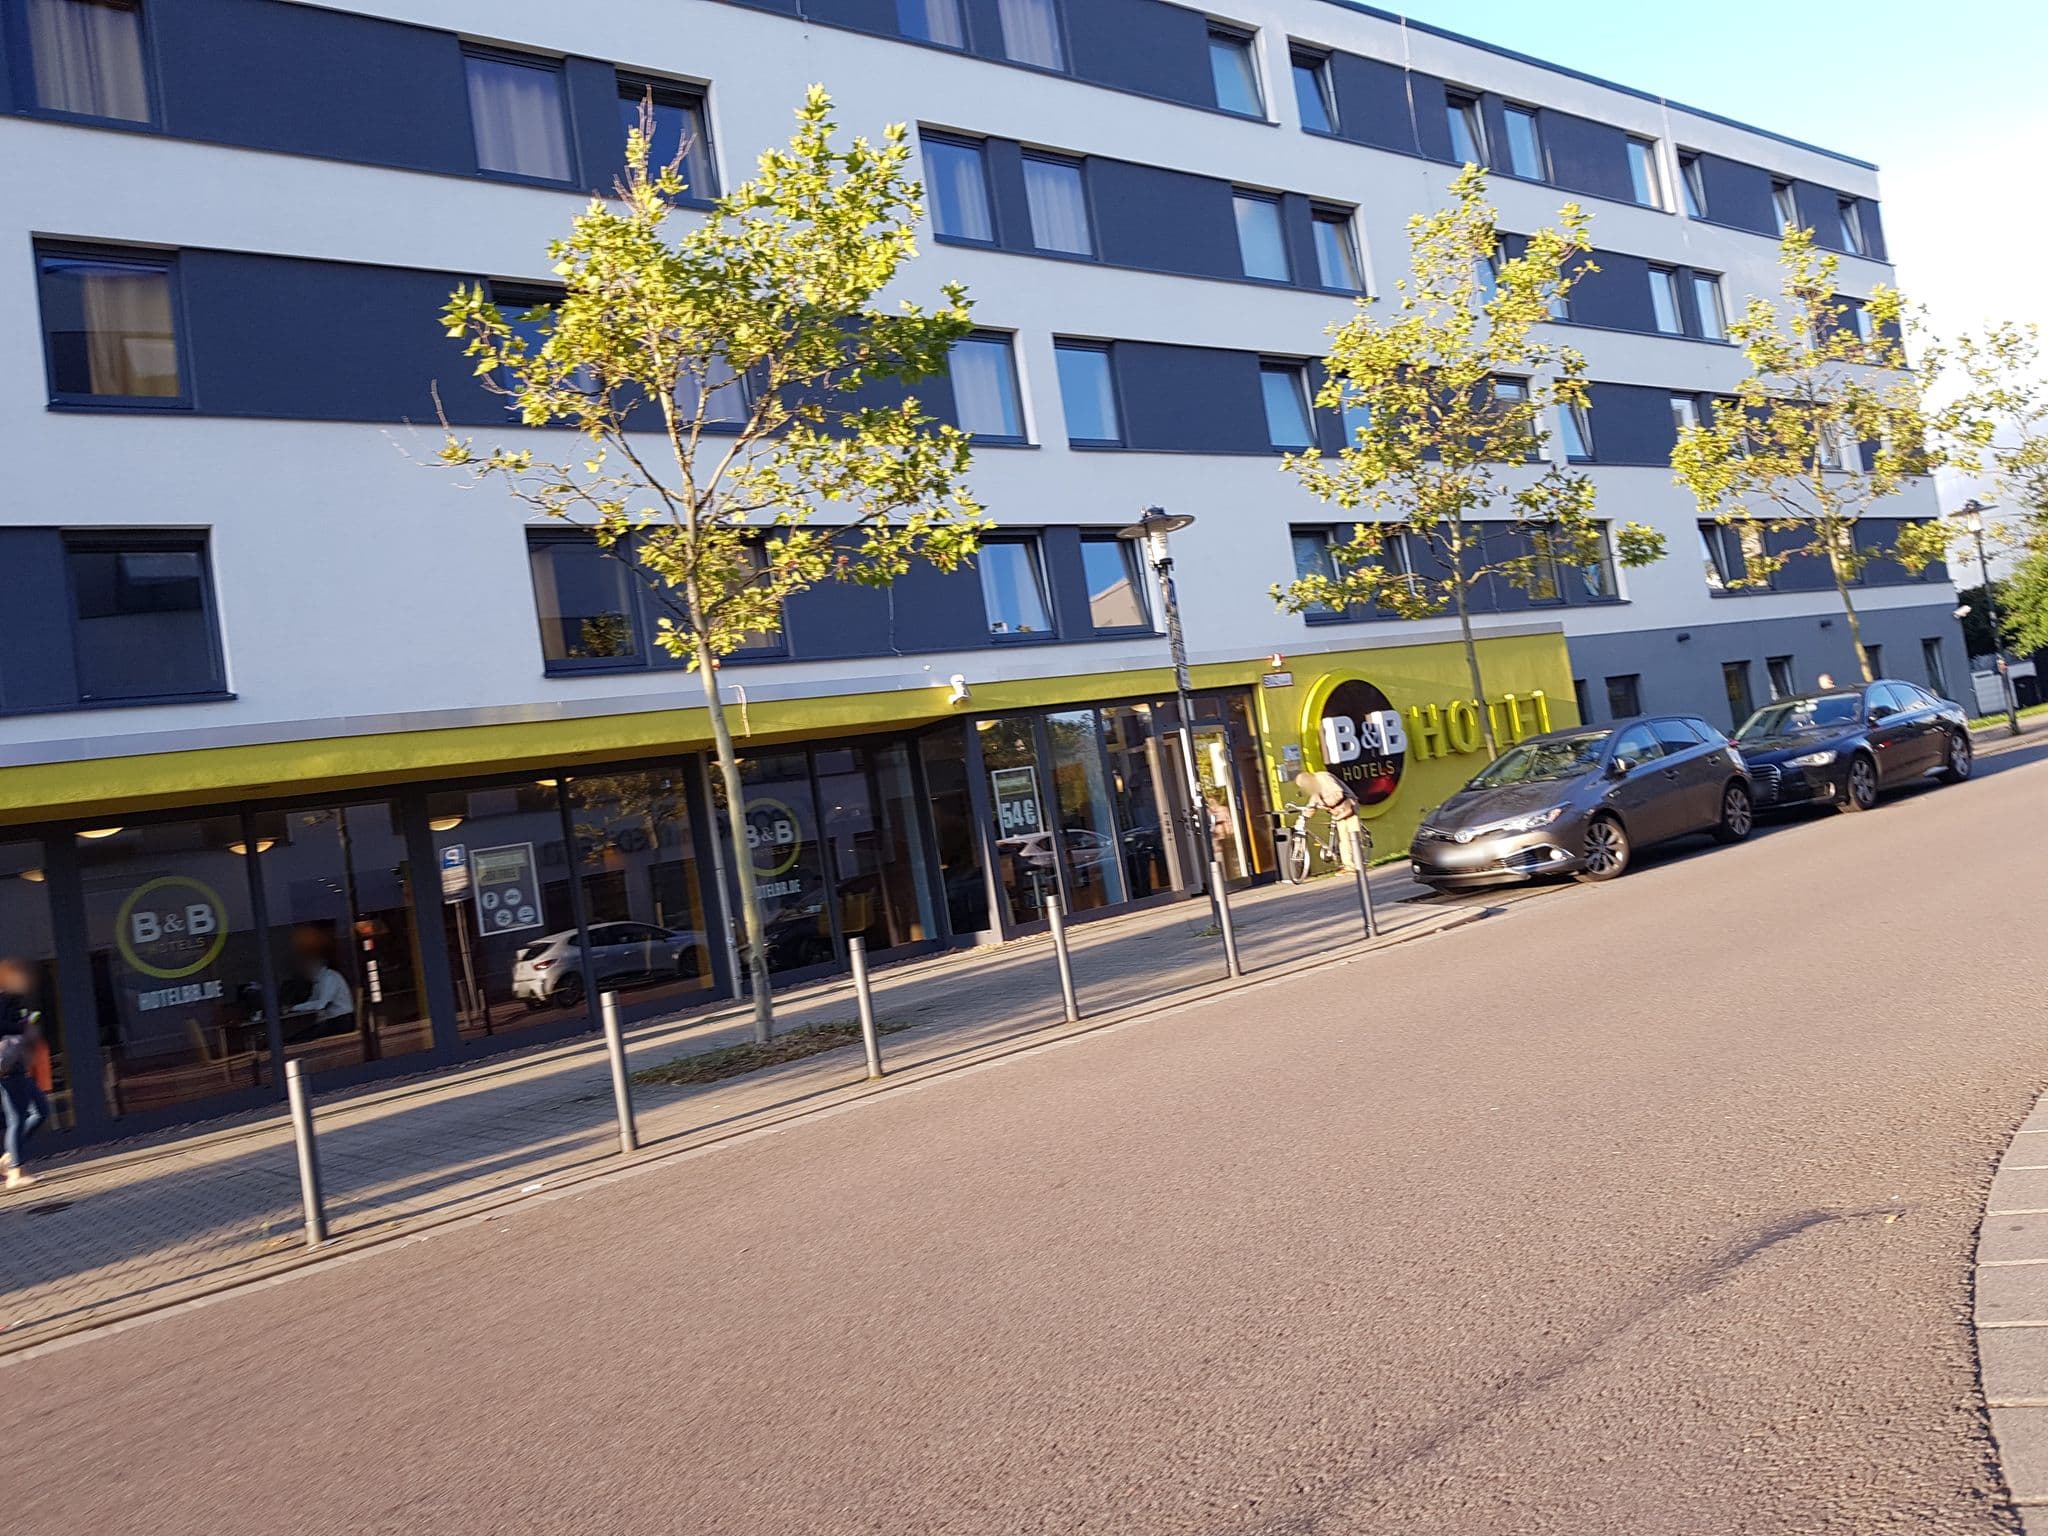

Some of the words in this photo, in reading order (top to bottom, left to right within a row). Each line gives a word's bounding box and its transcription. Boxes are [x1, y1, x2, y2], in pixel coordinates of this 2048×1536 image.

[1321, 710, 1408, 765] B&B
[1342, 760, 1395, 781] HOTELS
[1001, 799, 1037, 828] 54€
[745, 819, 794, 849] B&B
[131, 903, 216, 944] B&B
